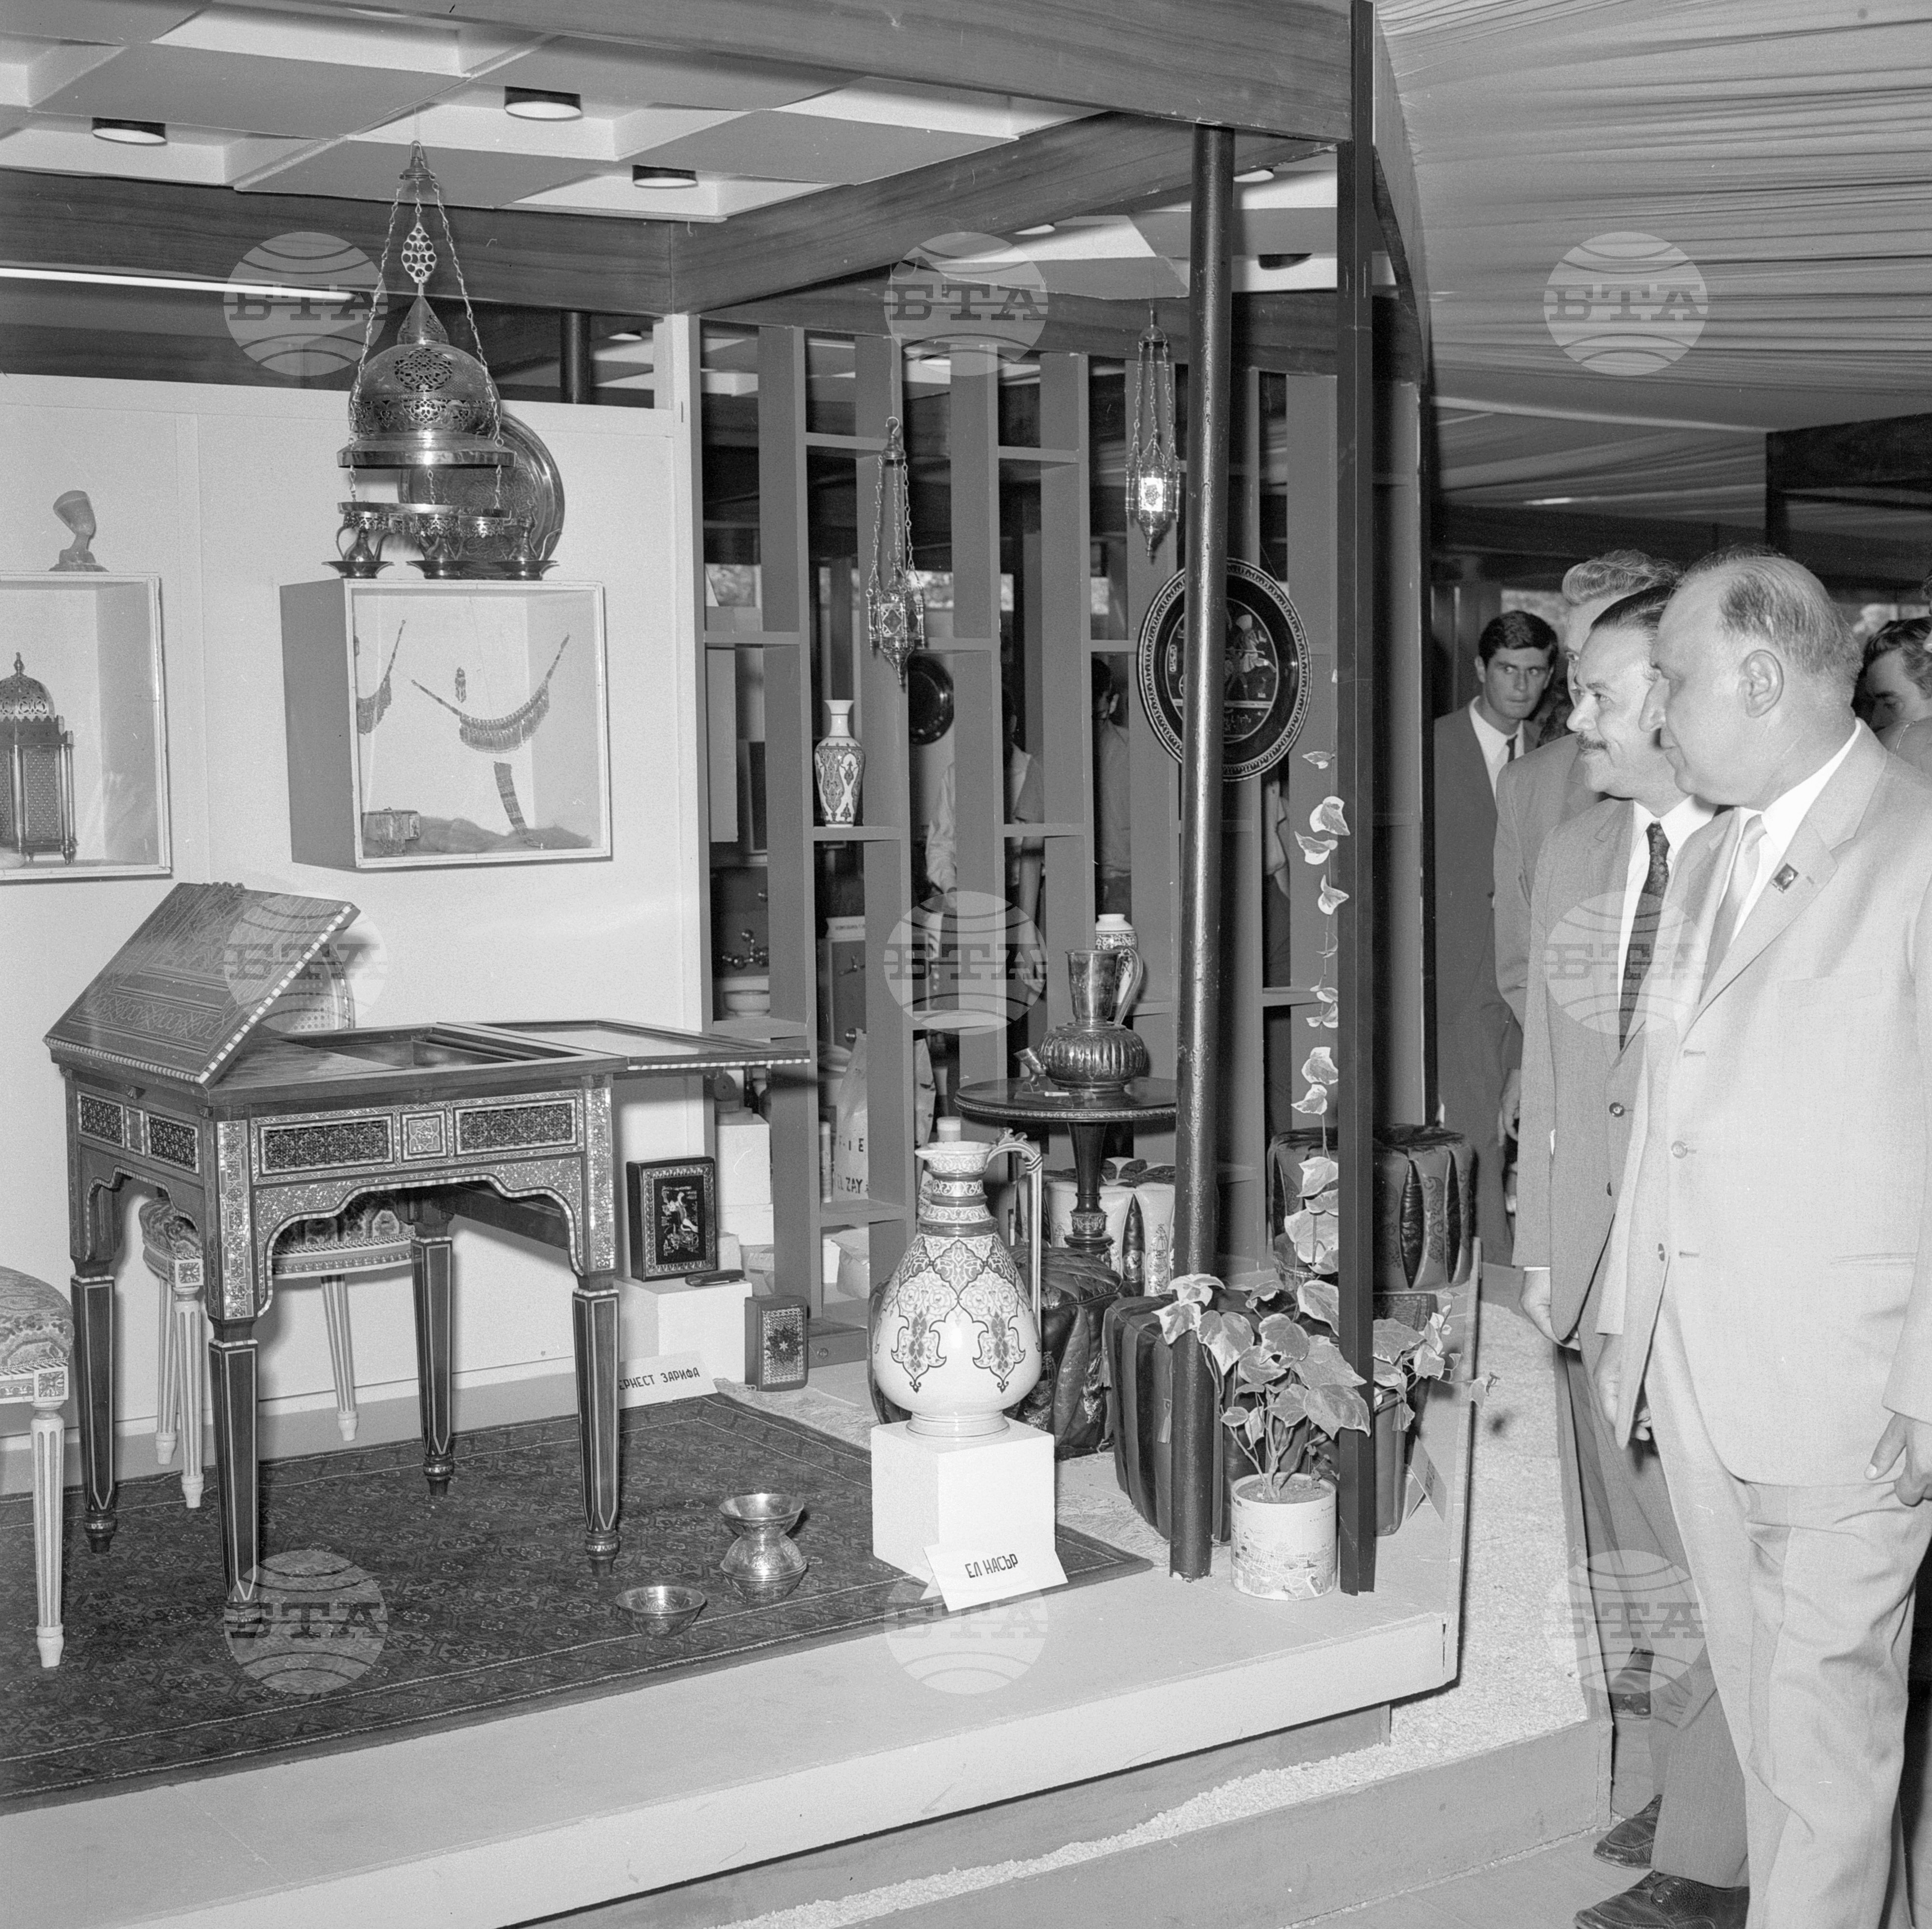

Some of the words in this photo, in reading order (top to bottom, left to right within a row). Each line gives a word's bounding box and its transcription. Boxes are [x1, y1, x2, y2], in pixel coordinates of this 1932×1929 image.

[660, 1367, 700, 1383] ЗАРИФА
[965, 1561, 983, 1578] ЕЛ
[982, 1553, 1019, 1574] НАСЪР
